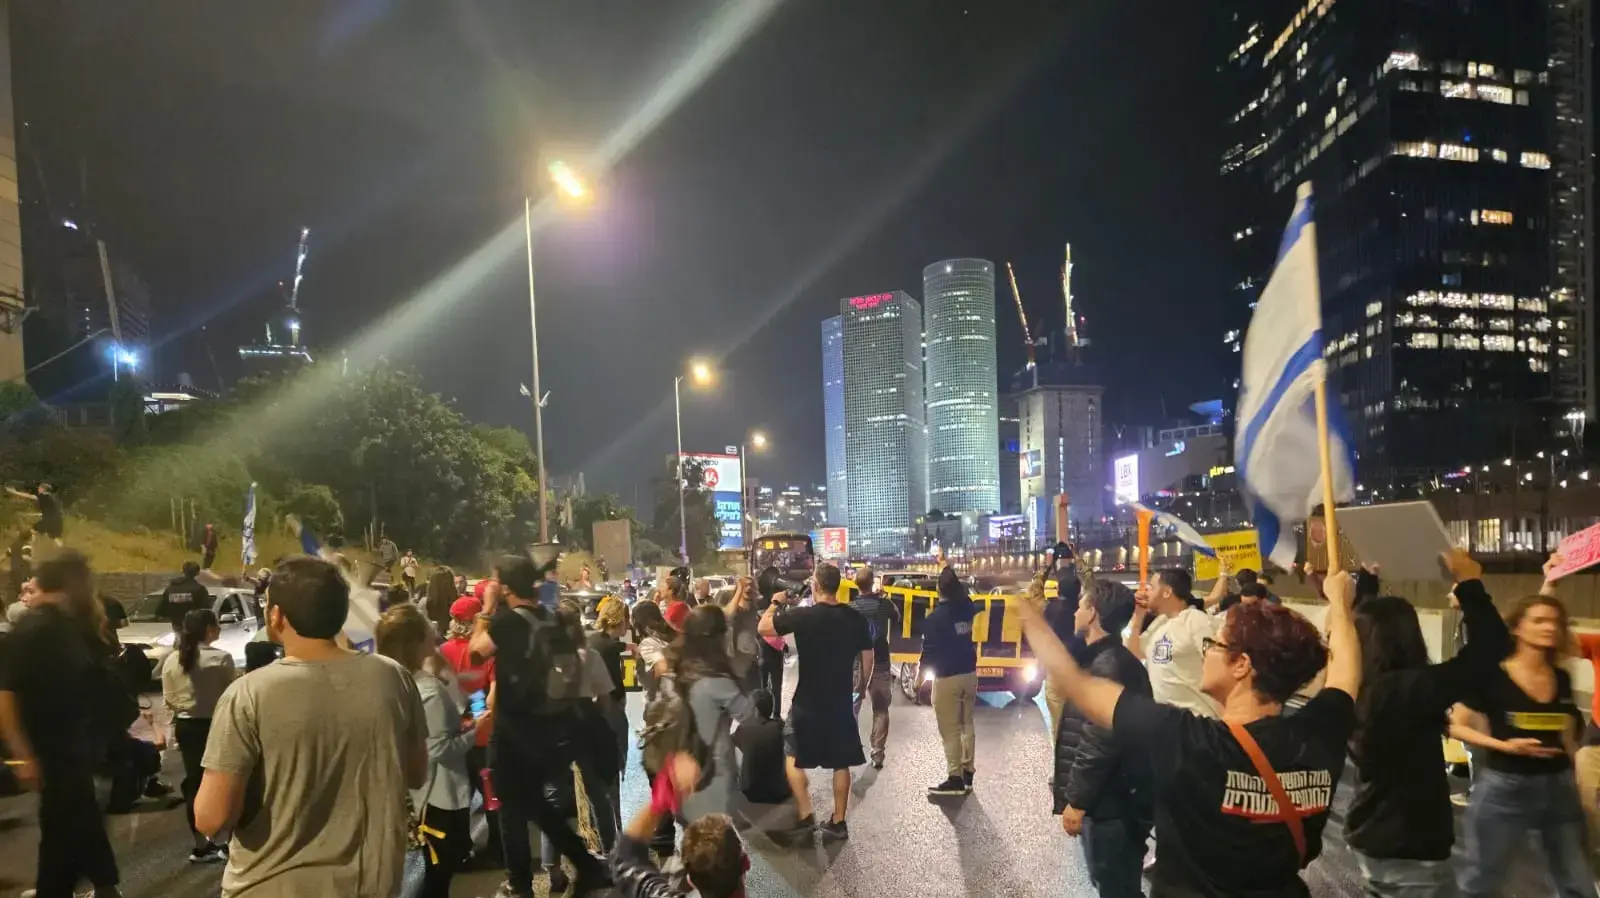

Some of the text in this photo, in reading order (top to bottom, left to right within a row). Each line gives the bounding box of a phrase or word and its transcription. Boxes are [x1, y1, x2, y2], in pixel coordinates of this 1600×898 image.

[1276, 771, 1308, 790] המשפ
[1222, 787, 1331, 815] החטופי הנעדרים
